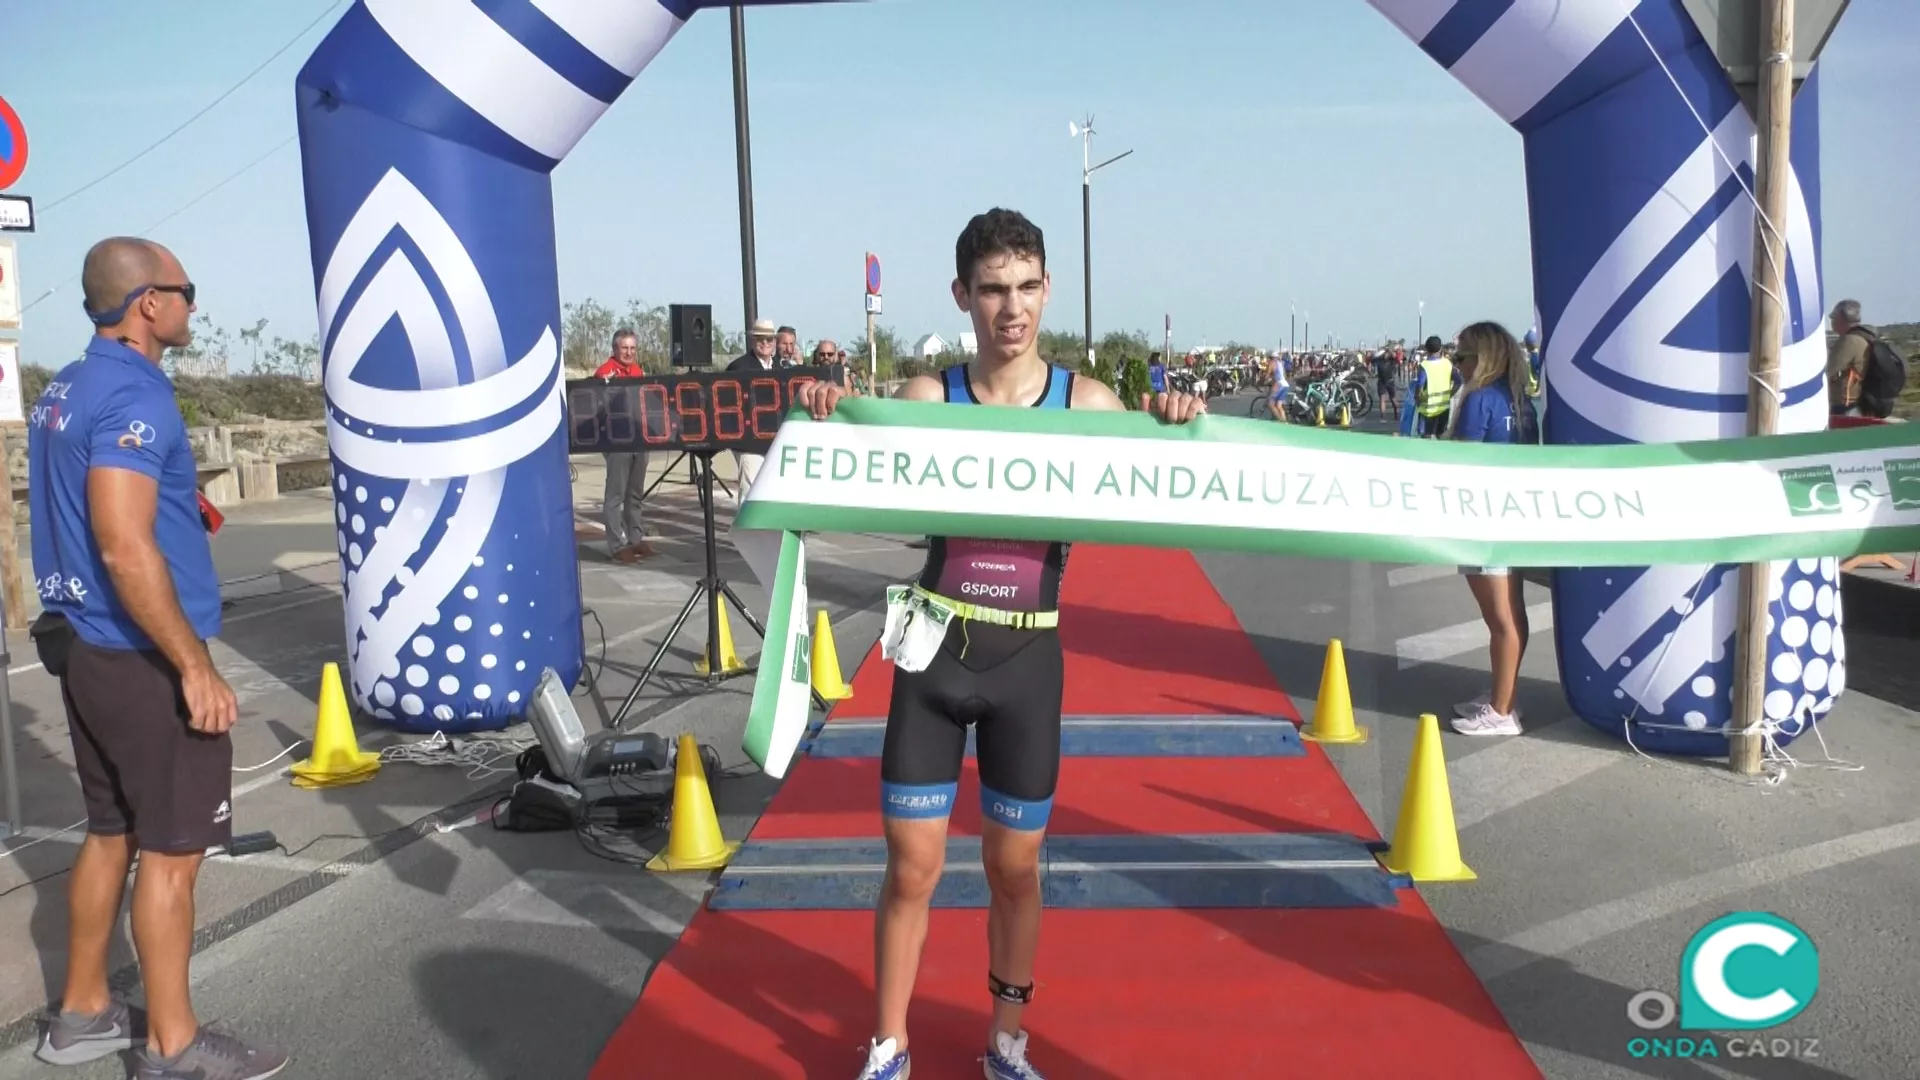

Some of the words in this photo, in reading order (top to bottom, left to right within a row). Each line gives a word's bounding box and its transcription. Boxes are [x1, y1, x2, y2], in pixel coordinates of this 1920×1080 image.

[779, 444, 1076, 493] FEDERACION
[1094, 463, 1350, 508] ANDALUZA
[1368, 478, 1418, 512] DE
[1433, 486, 1646, 519] TRIATLON
[961, 582, 1019, 599] GSPORT
[993, 803, 1023, 820] psi
